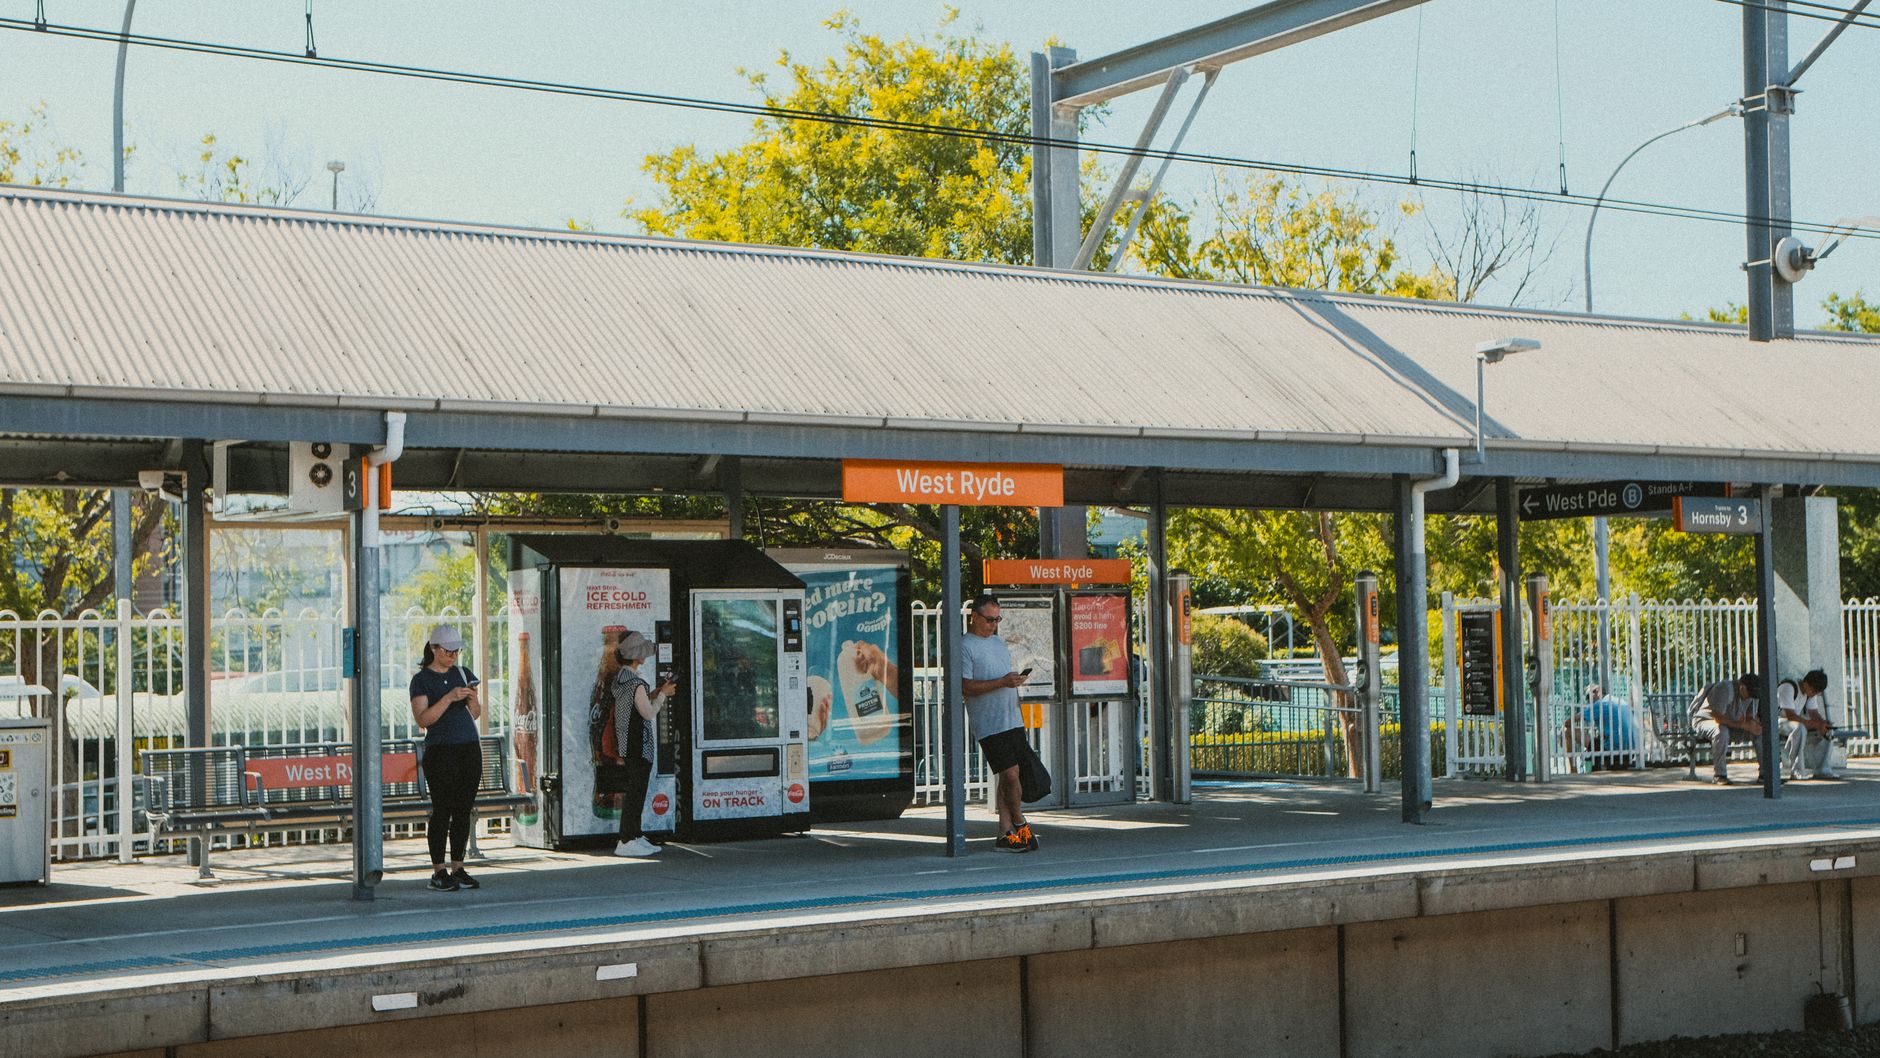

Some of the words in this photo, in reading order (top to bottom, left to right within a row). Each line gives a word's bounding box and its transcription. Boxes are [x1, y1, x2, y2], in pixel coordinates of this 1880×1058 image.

[348, 470, 356, 498] 3
[896, 469, 954, 495] West
[960, 471, 1015, 501] Ryde
[1546, 494, 1584, 512] West
[1588, 489, 1616, 509] Pde
[1629, 489, 1638, 503] B
[1648, 484, 1678, 495] Stands
[1679, 482, 1693, 492] A-F
[1692, 511, 1732, 528] Hornsby
[1738, 505, 1748, 526] 3
[1030, 565, 1060, 579] West
[1063, 566, 1093, 582] Ryde
[586, 591, 609, 602] ICE
[612, 591, 647, 602] COLD
[825, 577, 873, 600] more
[586, 602, 652, 611] REFRESHMENT
[1074, 612, 1091, 620] avoid
[1073, 621, 1092, 630] $200
[1094, 621, 1108, 629] fine
[285, 764, 331, 782] West
[703, 798, 720, 809] ON
[724, 796, 765, 807] TRACK
